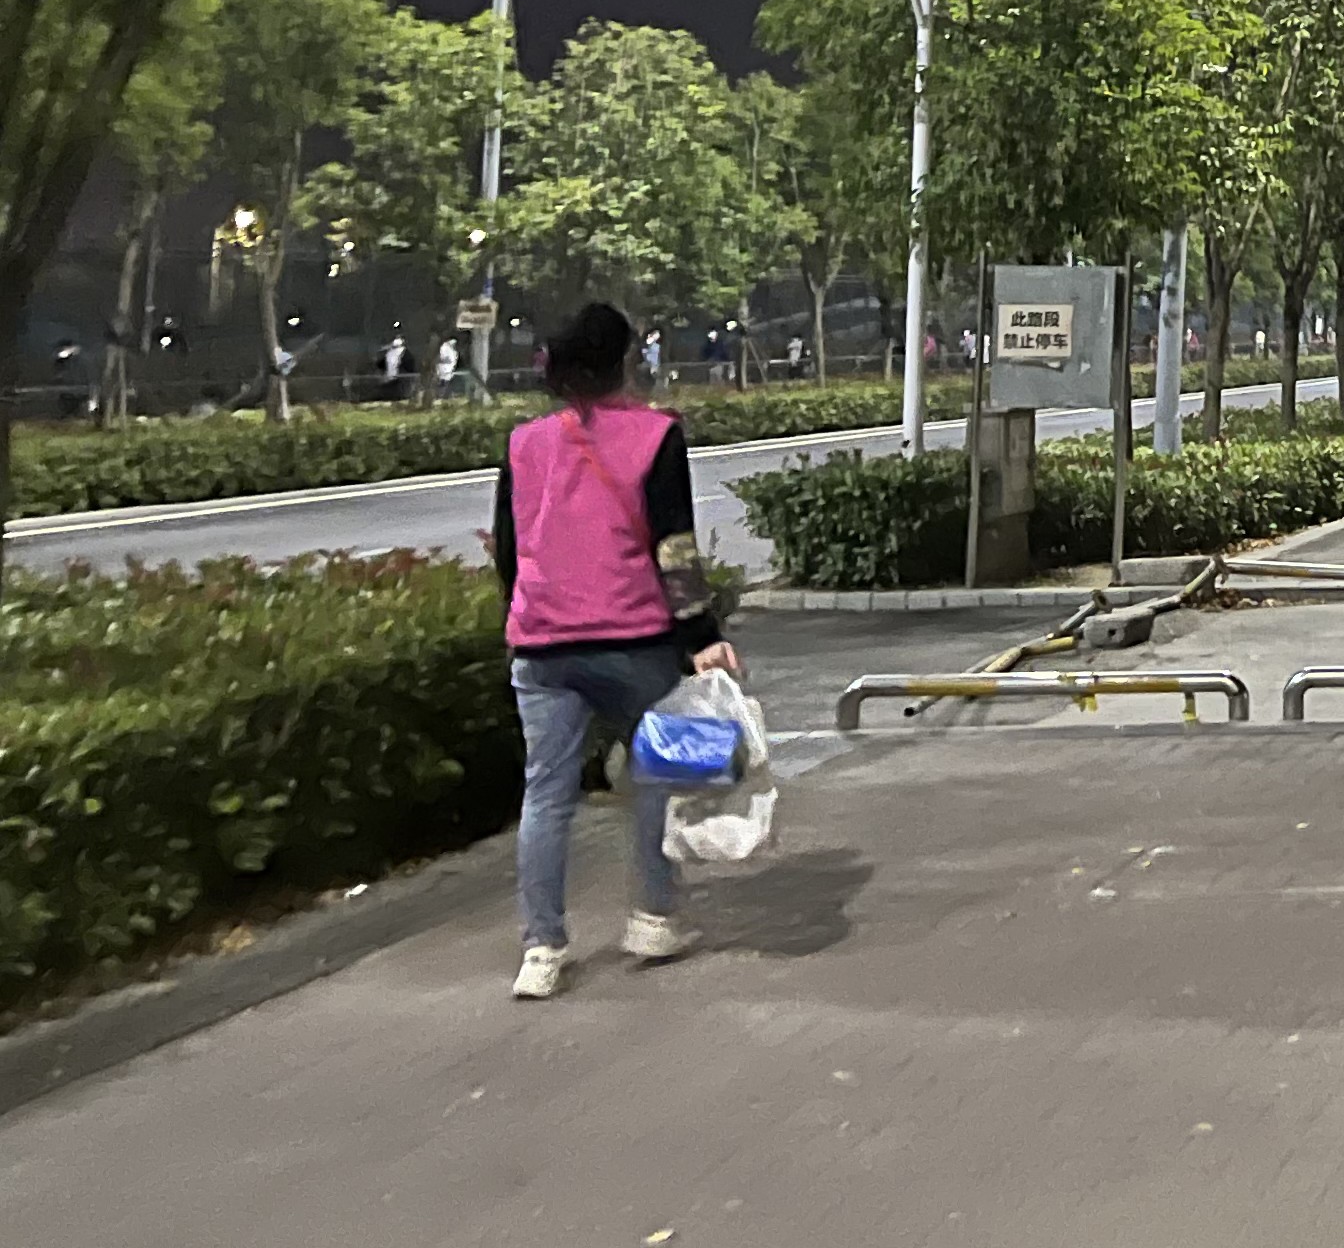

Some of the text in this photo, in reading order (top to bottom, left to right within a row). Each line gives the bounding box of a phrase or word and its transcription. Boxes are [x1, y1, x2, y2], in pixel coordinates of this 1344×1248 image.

[1010, 310, 1060, 328] 此路段
[1003, 332, 1068, 350] 禁止停车
